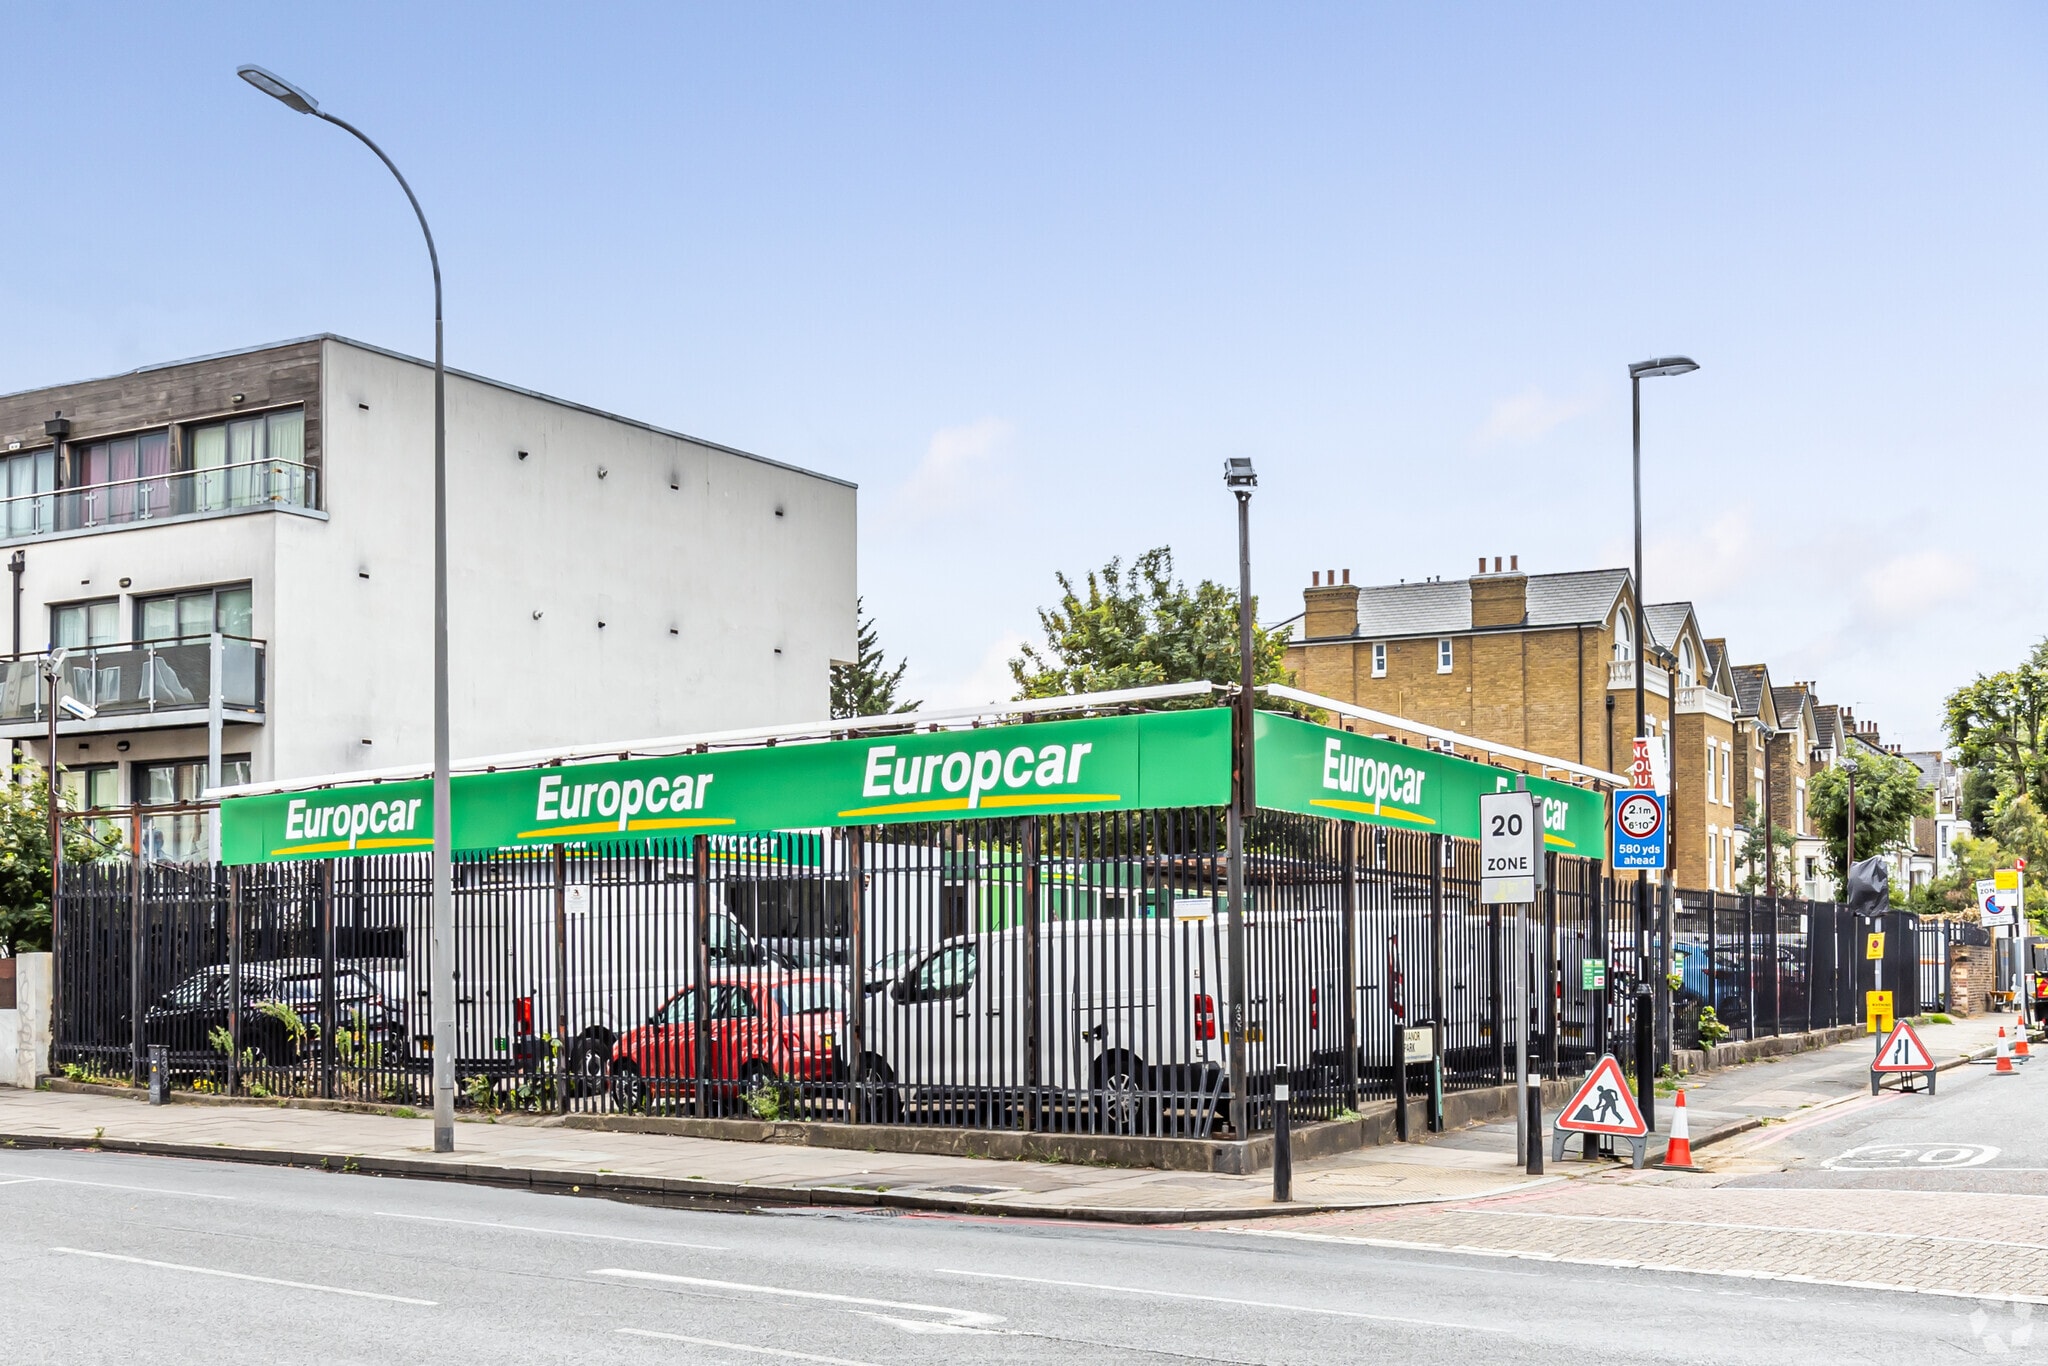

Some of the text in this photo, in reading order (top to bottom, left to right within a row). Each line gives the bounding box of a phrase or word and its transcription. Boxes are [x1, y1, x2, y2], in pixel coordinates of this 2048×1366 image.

[862, 742, 1093, 809] Europcar
[1323, 737, 1426, 816] Europcar
[536, 773, 714, 832] Europcar
[285, 798, 422, 850] Europcar
[1491, 814, 1523, 837] 20
[1619, 844, 1661, 857] 580 yds
[1623, 856, 1656, 865] ahead
[1487, 857, 1528, 871] ZONE
[2016, 860, 2023, 869] L
